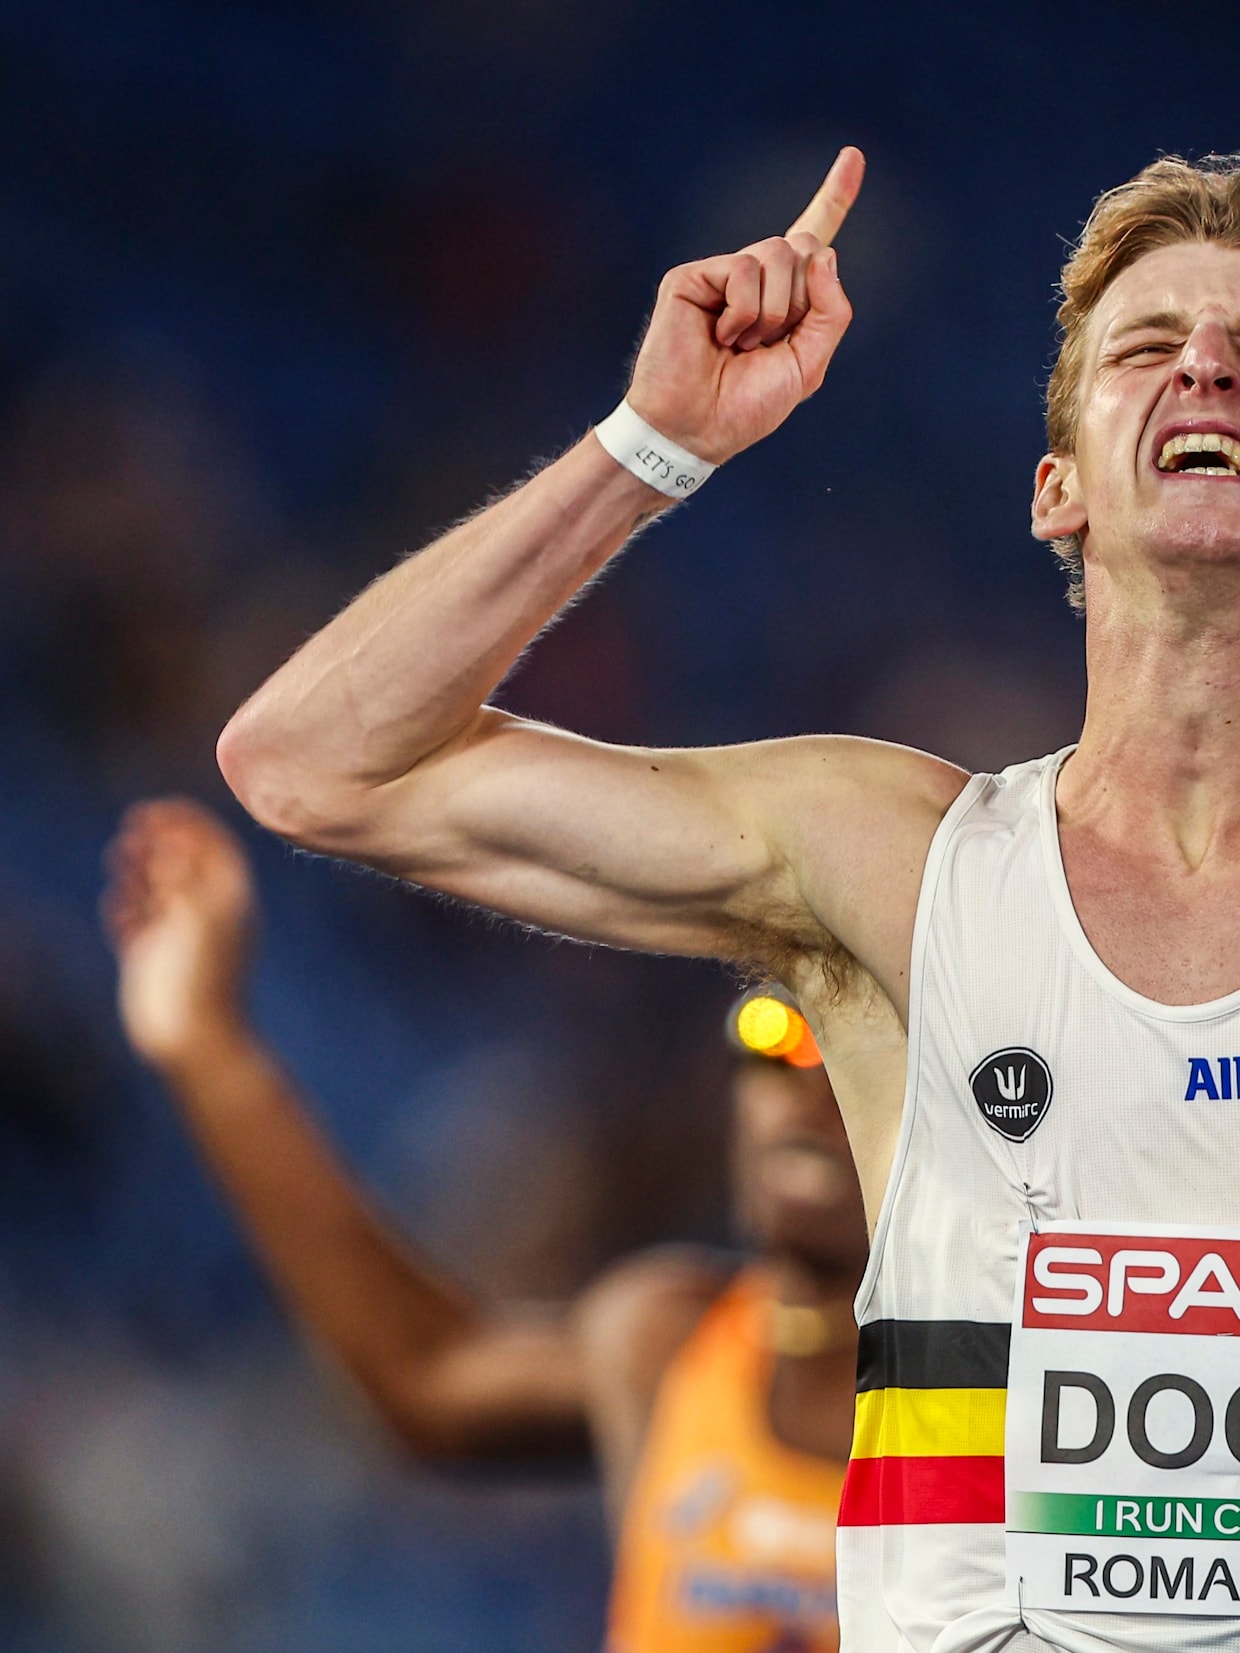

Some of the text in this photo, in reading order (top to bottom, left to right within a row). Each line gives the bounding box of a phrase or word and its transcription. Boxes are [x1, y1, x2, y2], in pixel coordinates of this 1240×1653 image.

[635, 446, 675, 479] LET'S
[1095, 1499, 1104, 1531] I
[1115, 1500, 1204, 1534] RUN
[1063, 1552, 1240, 1602] ROMA
